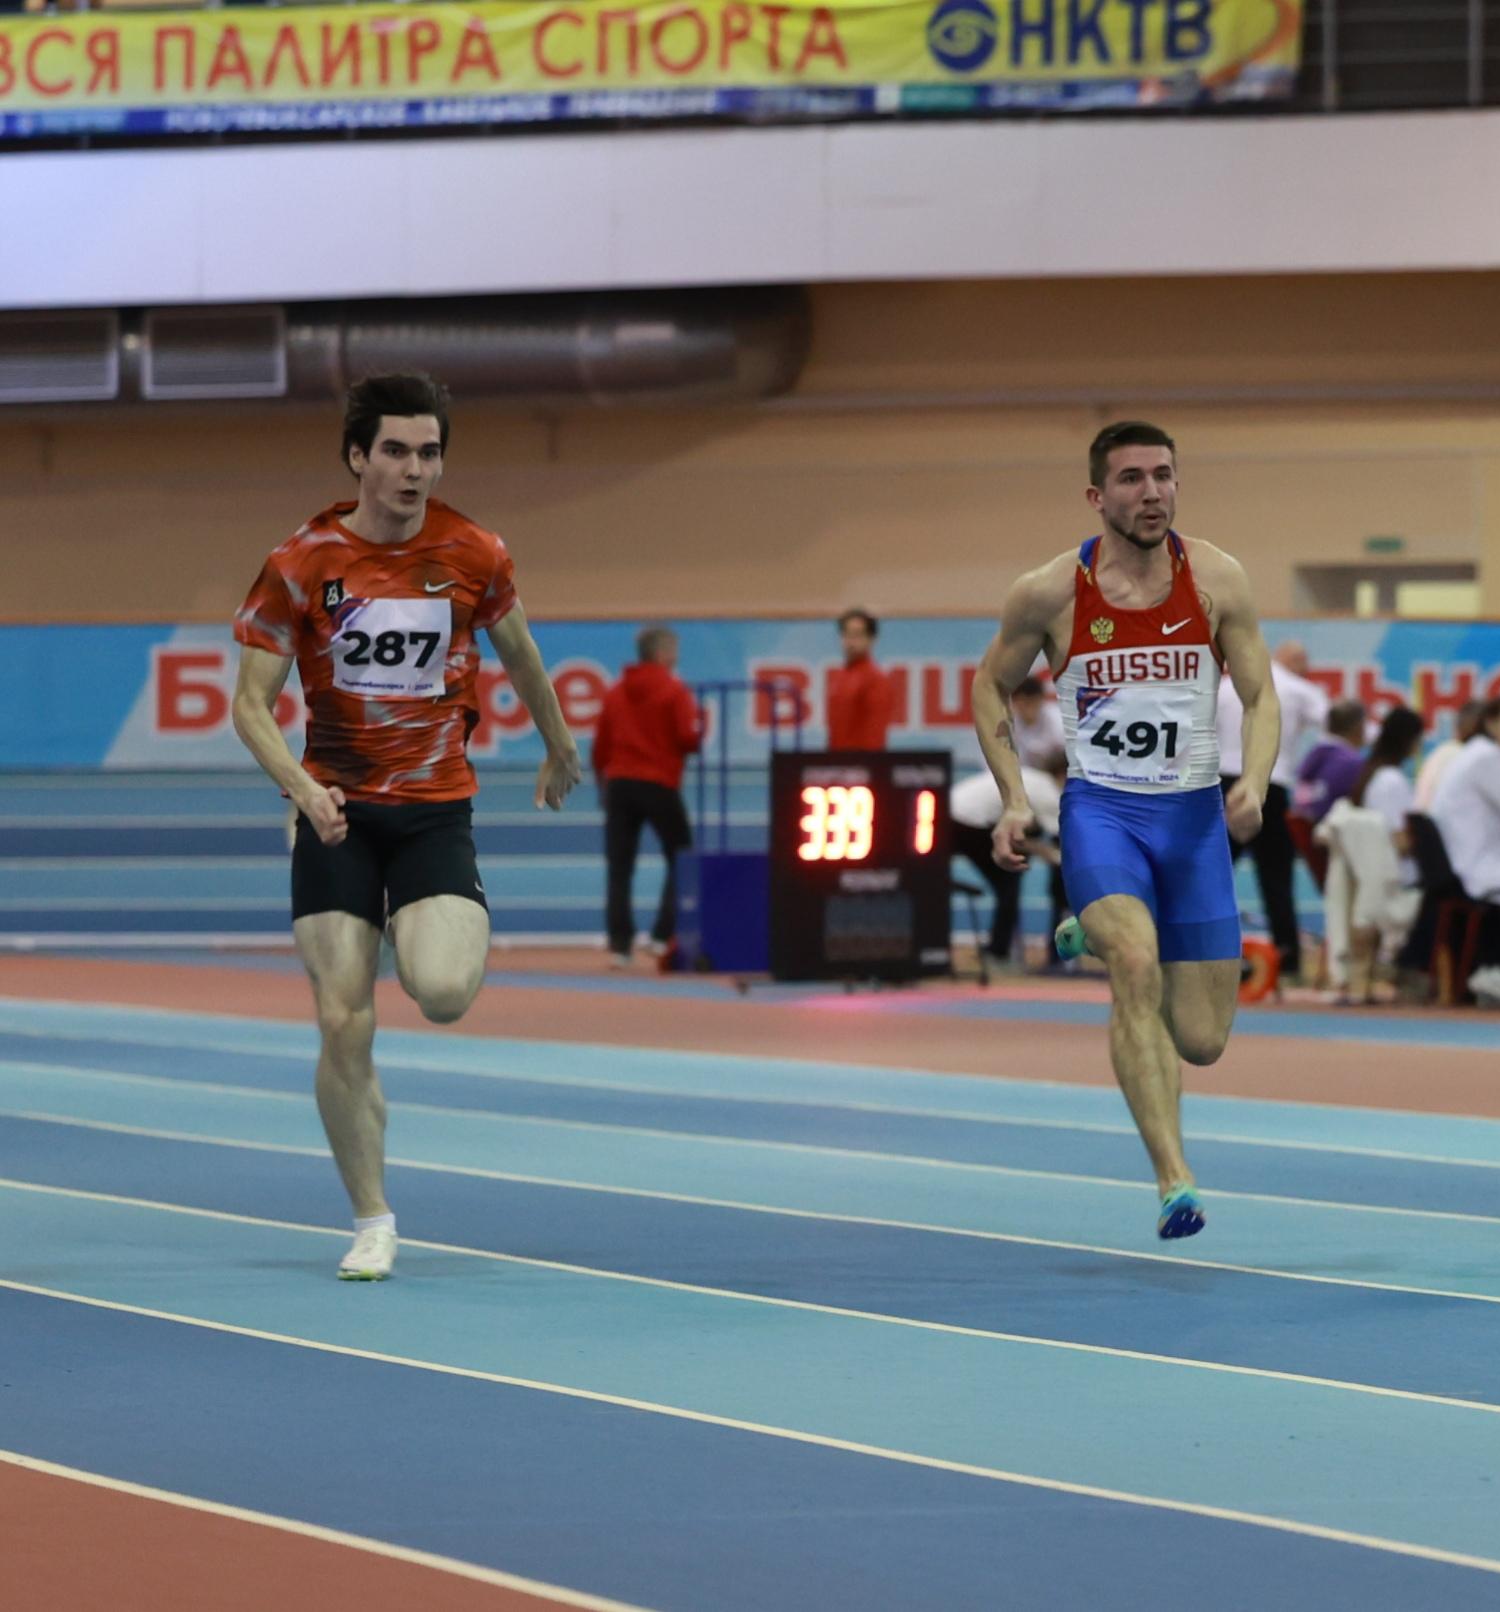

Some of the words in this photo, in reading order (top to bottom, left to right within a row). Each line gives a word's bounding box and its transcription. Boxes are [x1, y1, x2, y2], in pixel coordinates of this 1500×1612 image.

[154, 17, 501, 91] ПАЛИТРА
[533, 7, 848, 79] СПОРТА
[1011, 0, 1213, 67] НКТВ
[341, 630, 441, 668] 287
[1085, 650, 1200, 688] RUSSIA
[1090, 719, 1179, 759] 491
[915, 790, 936, 854] 1
